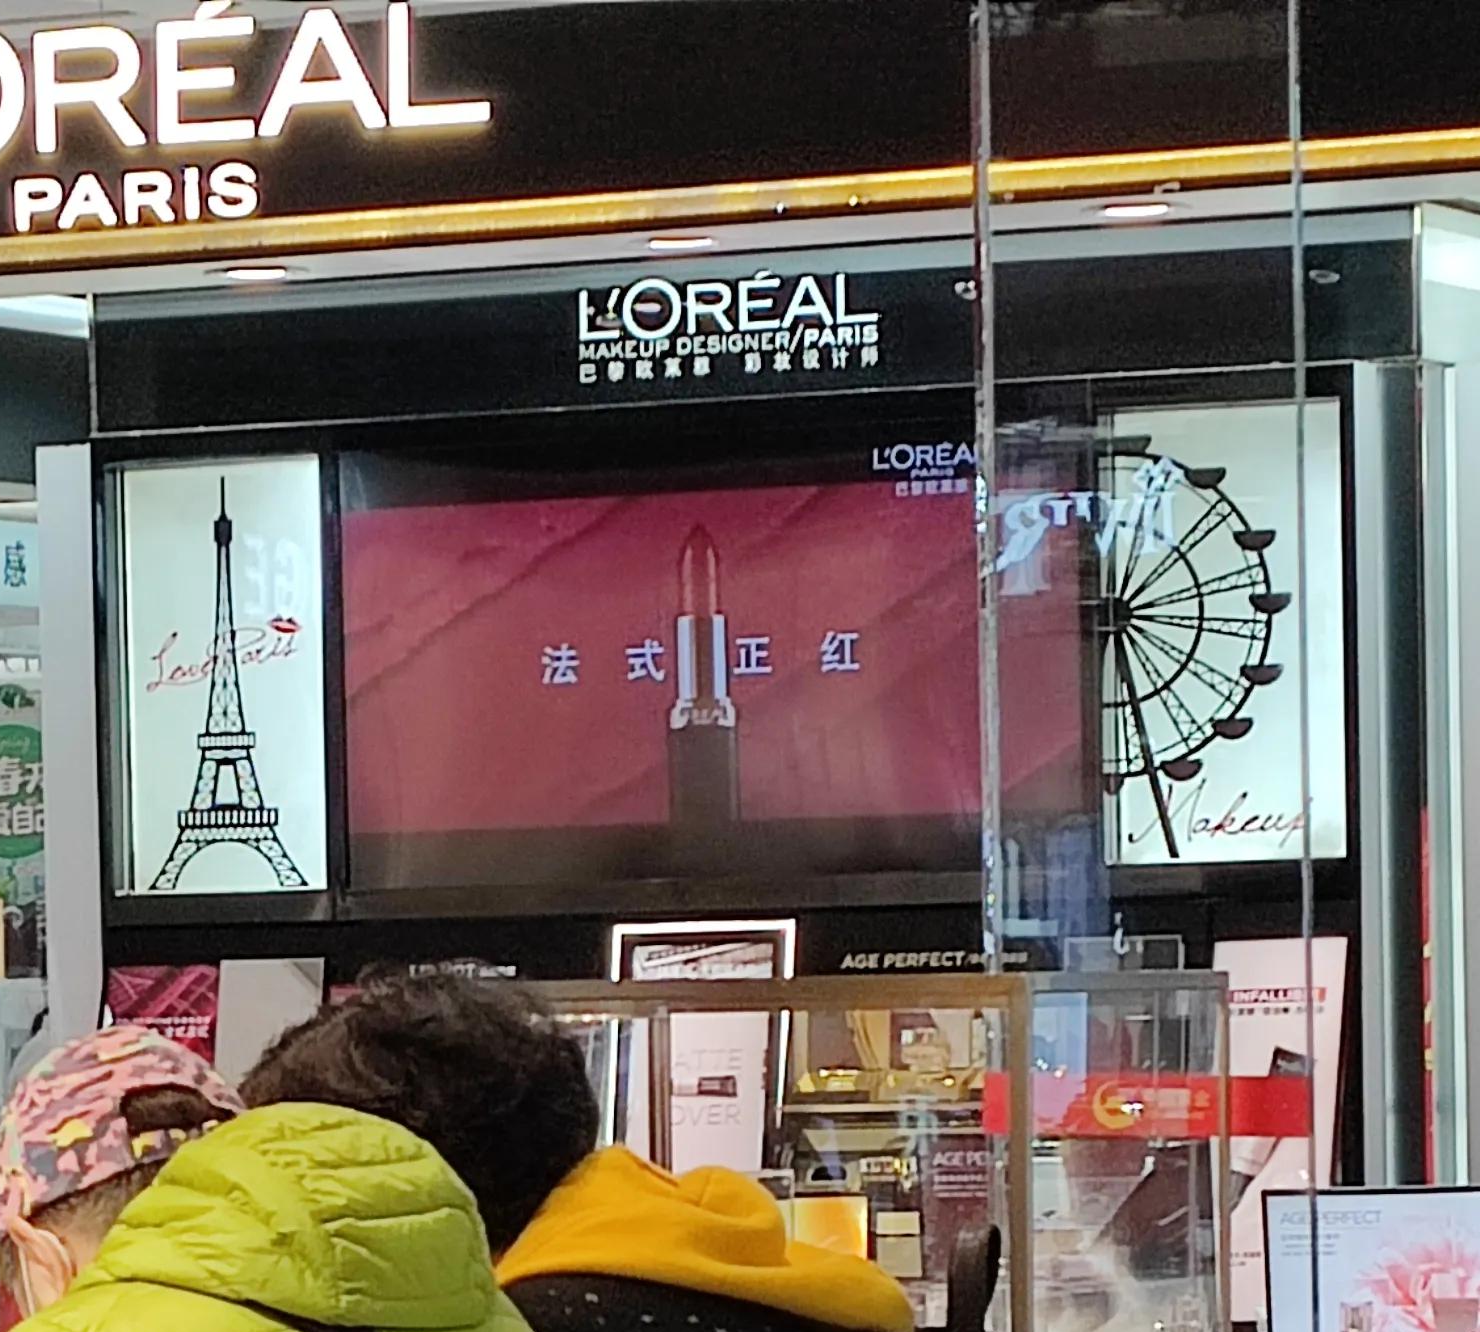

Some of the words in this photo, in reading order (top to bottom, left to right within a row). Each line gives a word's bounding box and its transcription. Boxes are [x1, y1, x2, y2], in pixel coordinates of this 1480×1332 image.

[13, 160, 260, 233] PARIS
[578, 269, 881, 341] L'ORÉAL
[578, 338, 670, 361] MAKEUP
[675, 323, 879, 356] DESIGNER/PARIS
[841, 952, 881, 970] AGE
[883, 950, 967, 969] PERFECT
